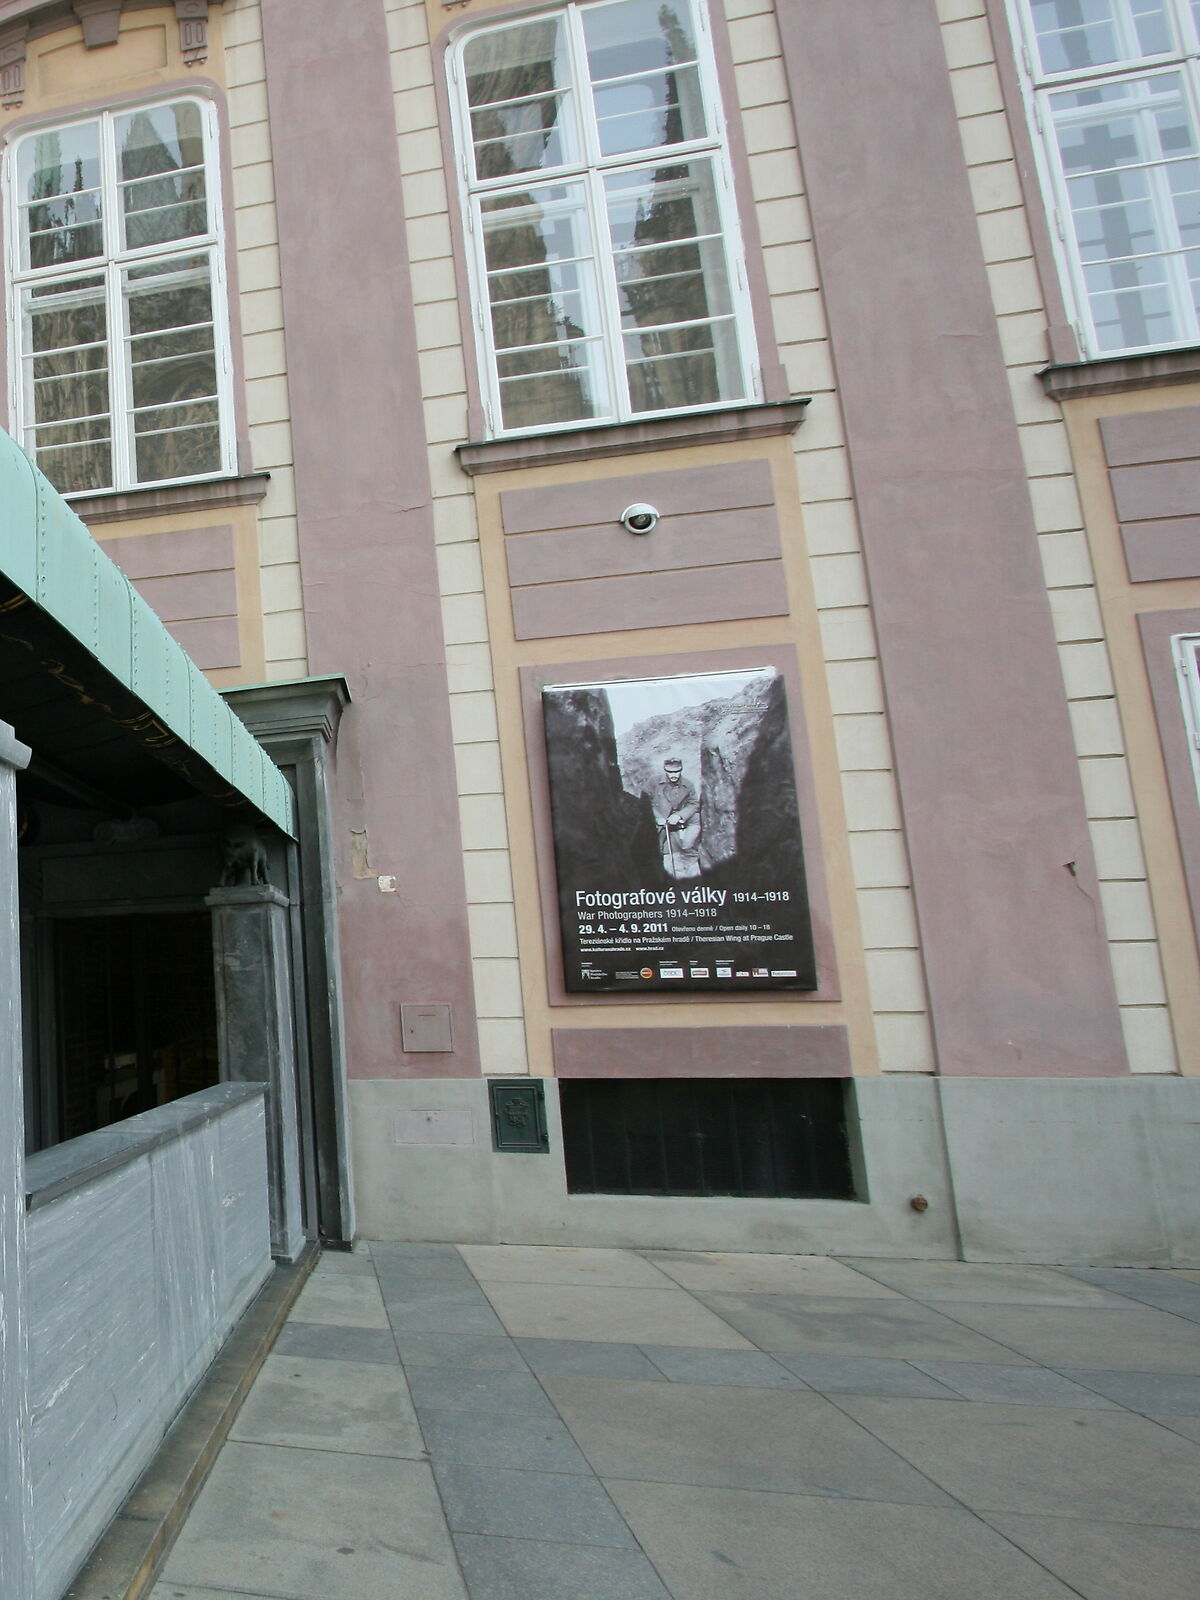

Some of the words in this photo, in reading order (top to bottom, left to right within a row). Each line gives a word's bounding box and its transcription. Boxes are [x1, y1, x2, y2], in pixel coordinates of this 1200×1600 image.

[576, 887, 676, 909] Fotografové
[681, 887, 727, 906] války
[578, 912, 594, 920] War
[598, 910, 662, 921] Photographers
[579, 925, 595, 934] 29.
[598, 925, 607, 934] 4.
[619, 924, 628, 933] 4.
[631, 924, 641, 933] 9.
[643, 923, 668, 932] 2011
